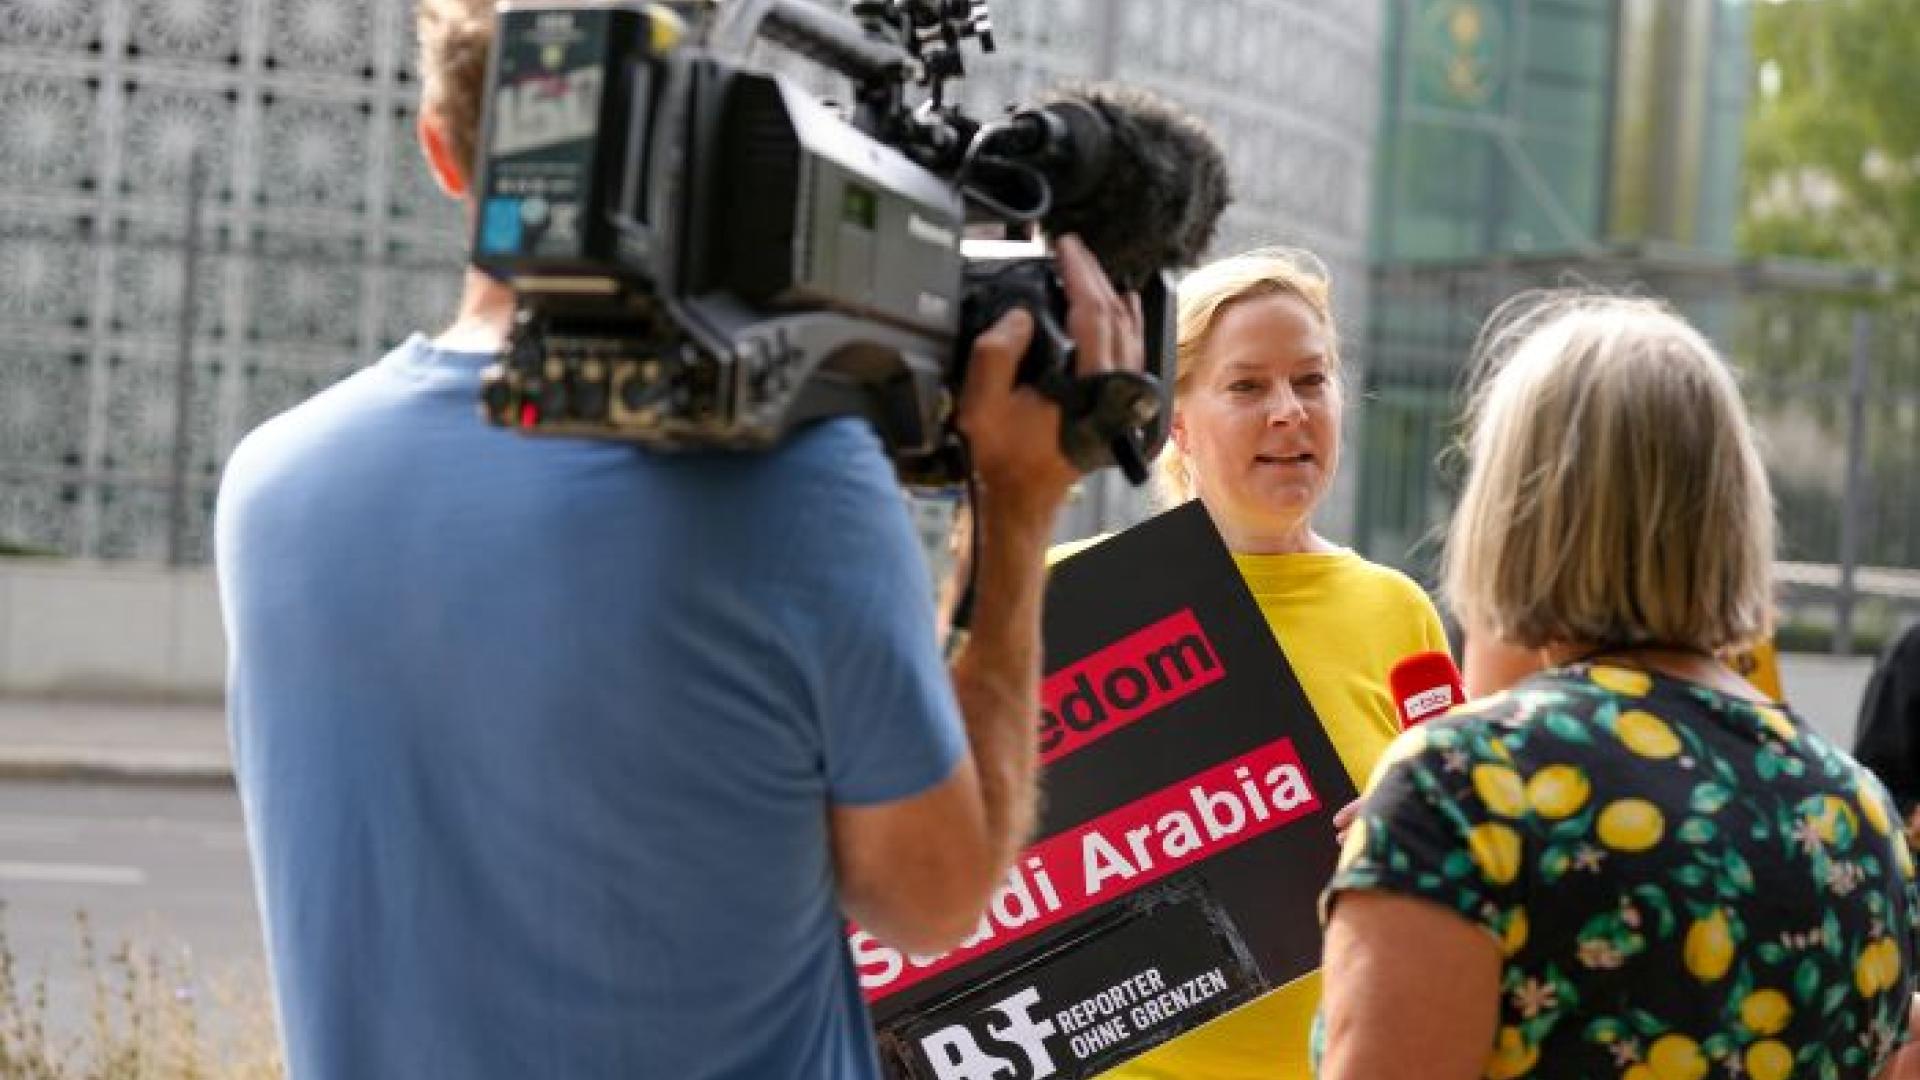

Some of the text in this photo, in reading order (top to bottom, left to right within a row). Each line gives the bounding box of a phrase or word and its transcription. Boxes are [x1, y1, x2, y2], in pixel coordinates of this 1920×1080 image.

[850, 763, 1313, 987] Sdi Arabia
[1056, 967, 1166, 1035] REPORTER
[1068, 967, 1229, 1059] OHNE GRENZEN
